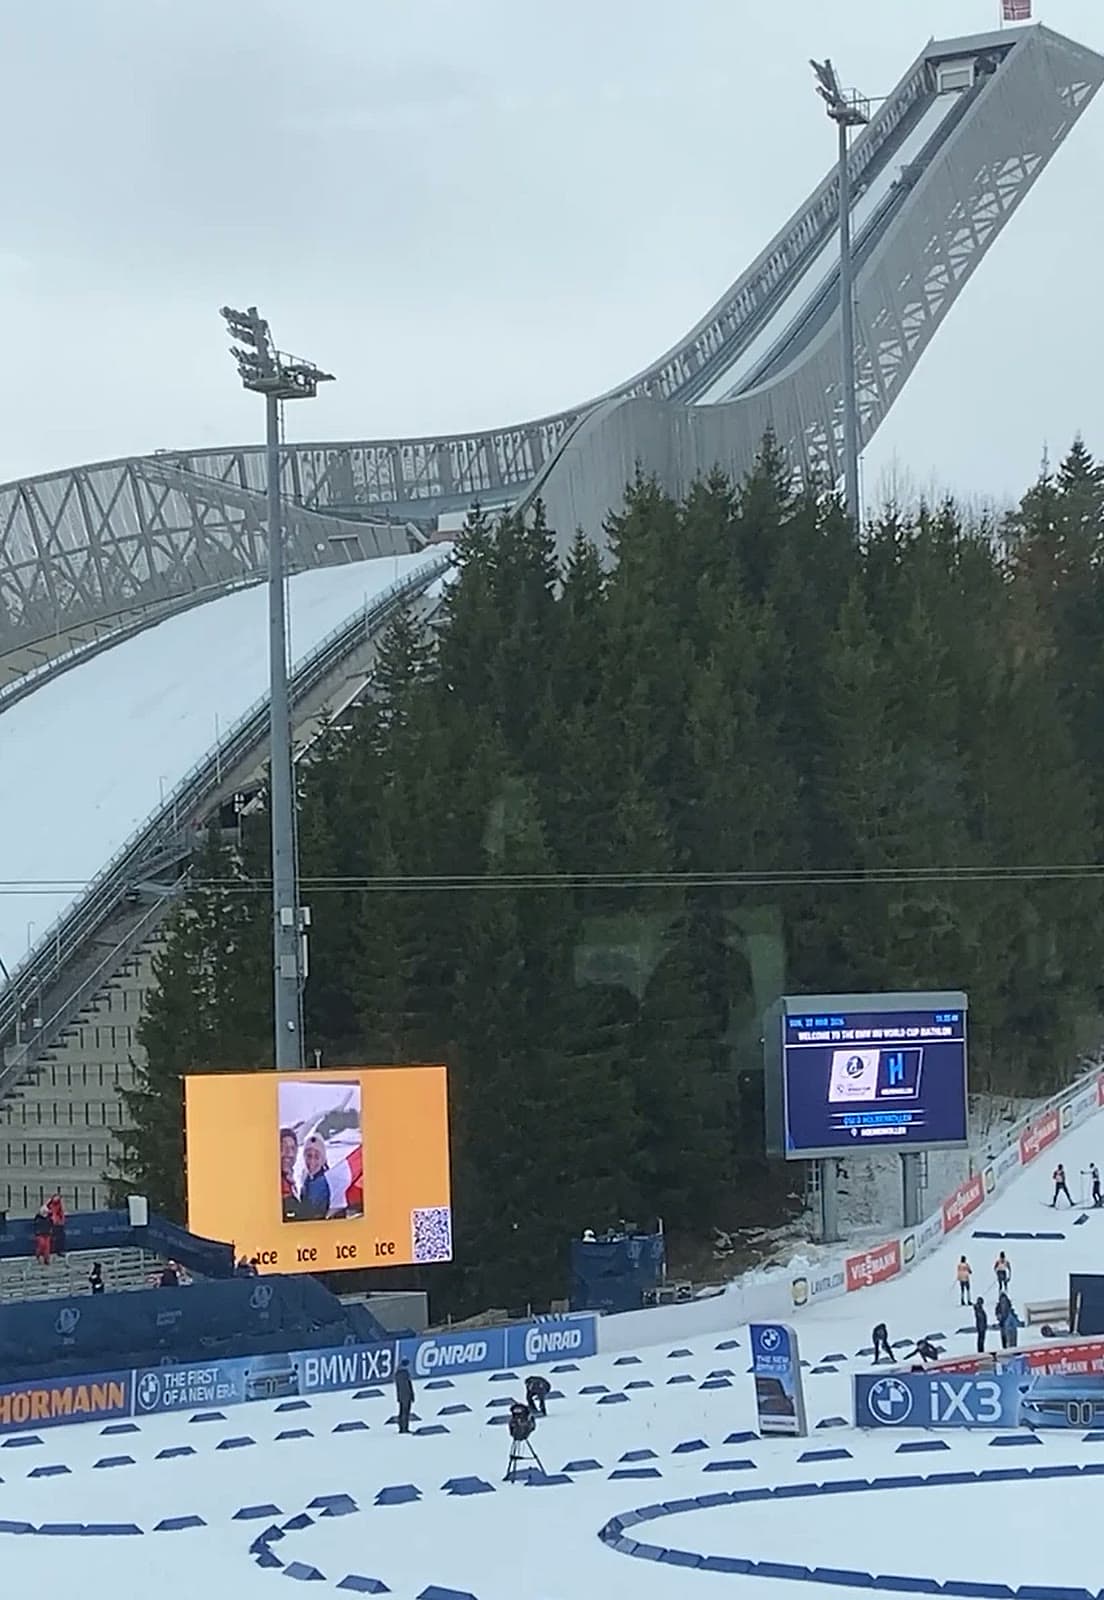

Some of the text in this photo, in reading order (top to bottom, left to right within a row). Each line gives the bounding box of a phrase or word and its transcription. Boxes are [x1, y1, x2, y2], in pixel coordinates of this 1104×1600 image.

[798, 1031, 830, 1041] WELCOME
[831, 1031, 841, 1040] TO
[883, 1028, 906, 1038] WORLD
[906, 1027, 920, 1037] CUP
[297, 1245, 318, 1262] ice
[336, 1242, 357, 1259] ice
[375, 1239, 396, 1256] ice
[850, 1251, 897, 1285] VIESSMANN
[415, 1340, 488, 1376] CONRAD
[525, 1327, 582, 1362] CONRAD
[163, 1368, 219, 1389] THE FIRST
[305, 1348, 392, 1388] BMW iX3
[0, 1381, 125, 1425] HÖRMANN
[163, 1389, 179, 1406] OF
[179, 1388, 188, 1403] A
[188, 1386, 215, 1402] NEW
[930, 1381, 1003, 1422] iX3
